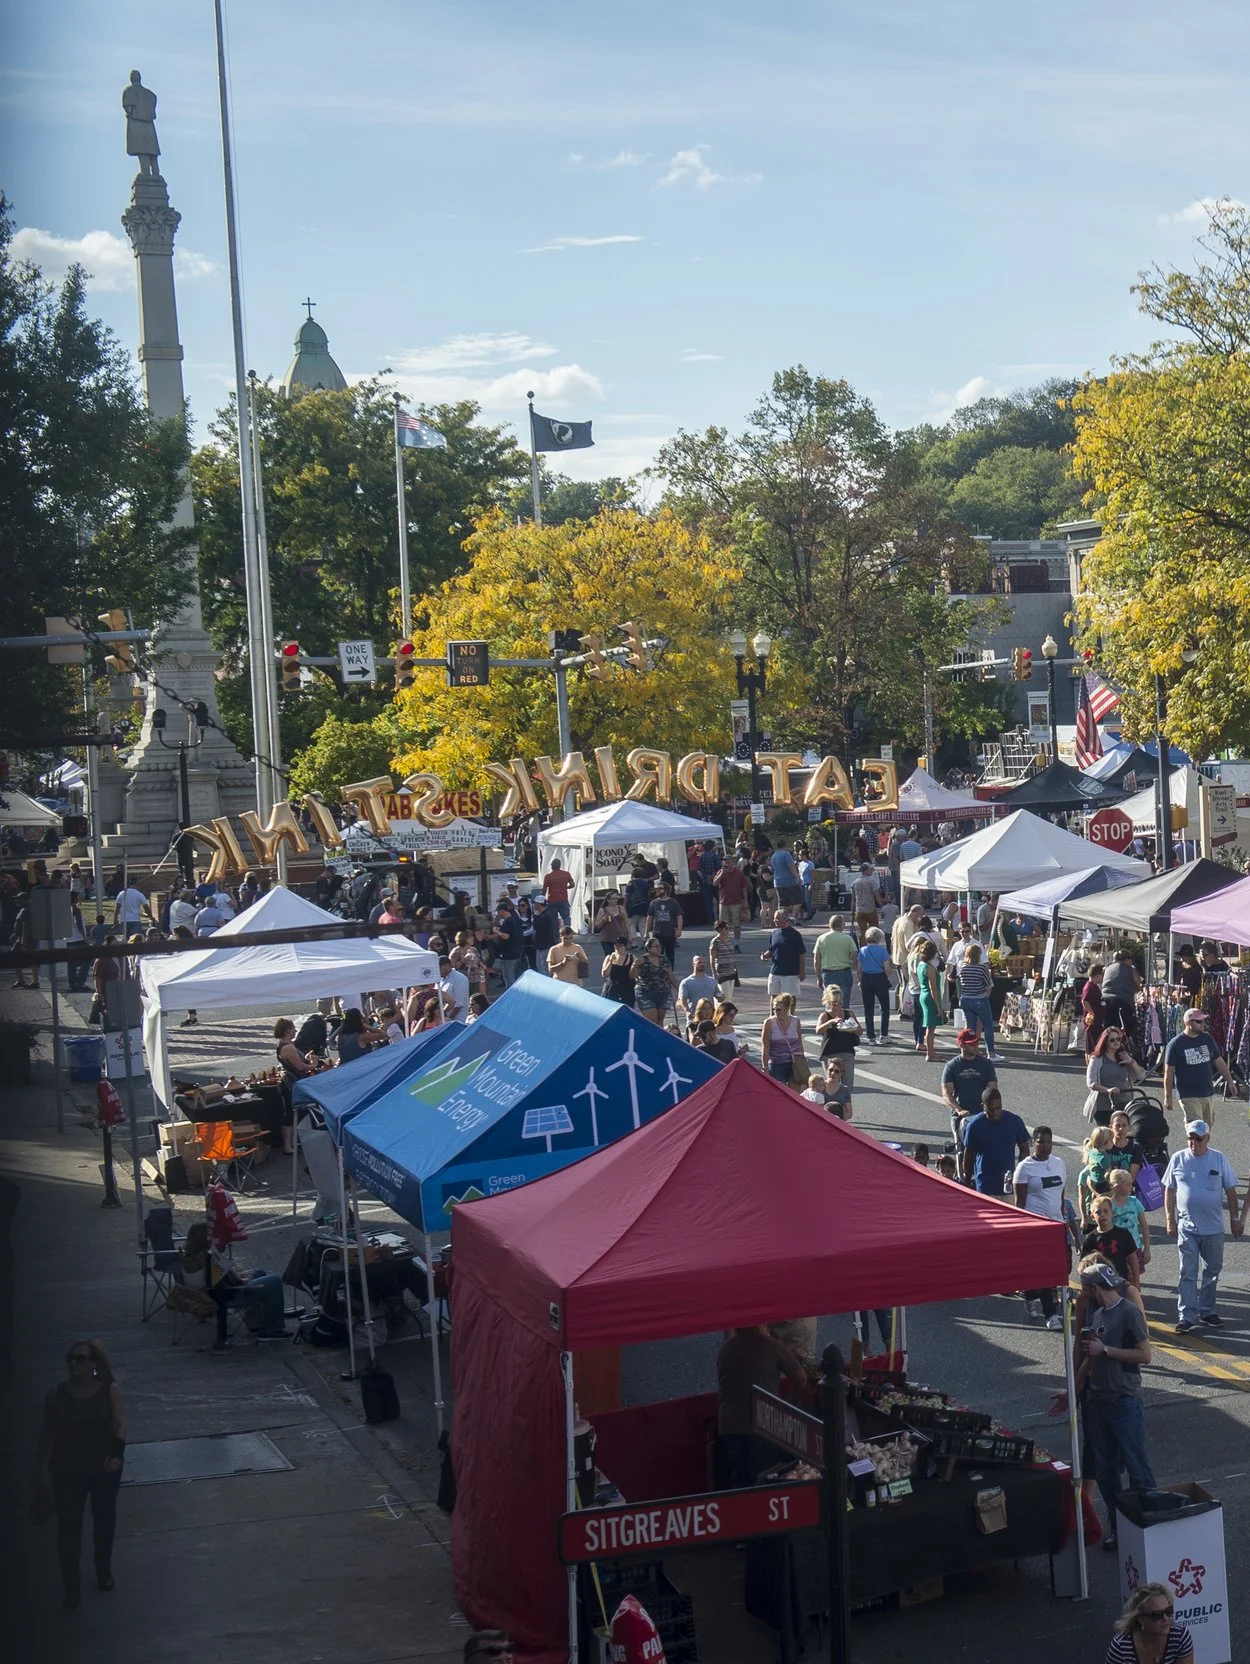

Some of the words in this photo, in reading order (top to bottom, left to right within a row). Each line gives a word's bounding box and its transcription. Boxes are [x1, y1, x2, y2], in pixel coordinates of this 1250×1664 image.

[345, 644, 367, 654] ONE
[460, 646, 476, 656] NO
[346, 655, 369, 664] WAY
[462, 666, 474, 674] ON
[1092, 822, 1130, 842] STOP
[586, 848, 623, 858] POCONO
[596, 857, 621, 867] SOAP
[497, 1040, 540, 1076] Green
[438, 1090, 488, 1132] Energy
[488, 1174, 525, 1186] Green
[756, 1399, 807, 1453] NORTHAMPTON
[585, 1503, 720, 1551] SITGREAVES
[769, 1496, 789, 1521] ST
[1175, 1603, 1222, 1620] PUBLIC
